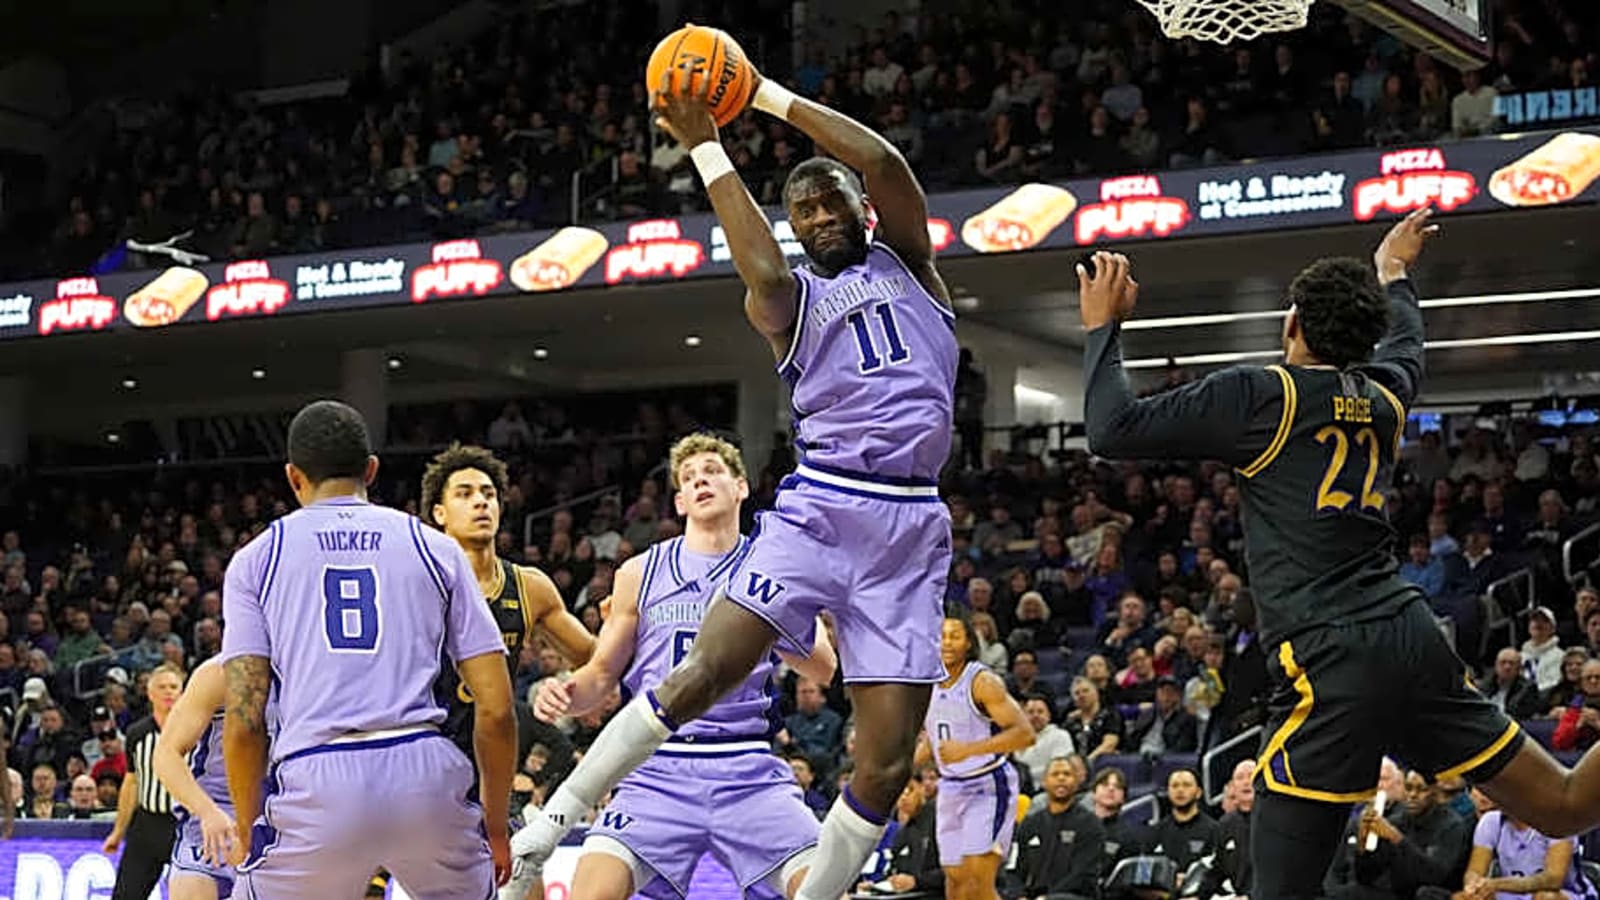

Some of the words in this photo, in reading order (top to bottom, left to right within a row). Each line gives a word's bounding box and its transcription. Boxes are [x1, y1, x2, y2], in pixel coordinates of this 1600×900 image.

[1381, 148, 1445, 174] PIZZA
[1101, 175, 1161, 200] PIZZA
[1246, 177, 1267, 199] &
[1353, 170, 1477, 221] PUFF
[1074, 196, 1190, 245] PUFF
[411, 259, 503, 304] PUFF
[605, 239, 705, 284] PUFF
[38, 294, 117, 336] PUFF
[206, 277, 290, 321] PUFF
[846, 297, 912, 376] 11
[1332, 396, 1373, 423] PAGE
[1314, 424, 1386, 512] 22
[314, 530, 383, 552] TUCKER
[320, 563, 383, 655] 8
[745, 569, 789, 608] W
[602, 810, 635, 830] W
